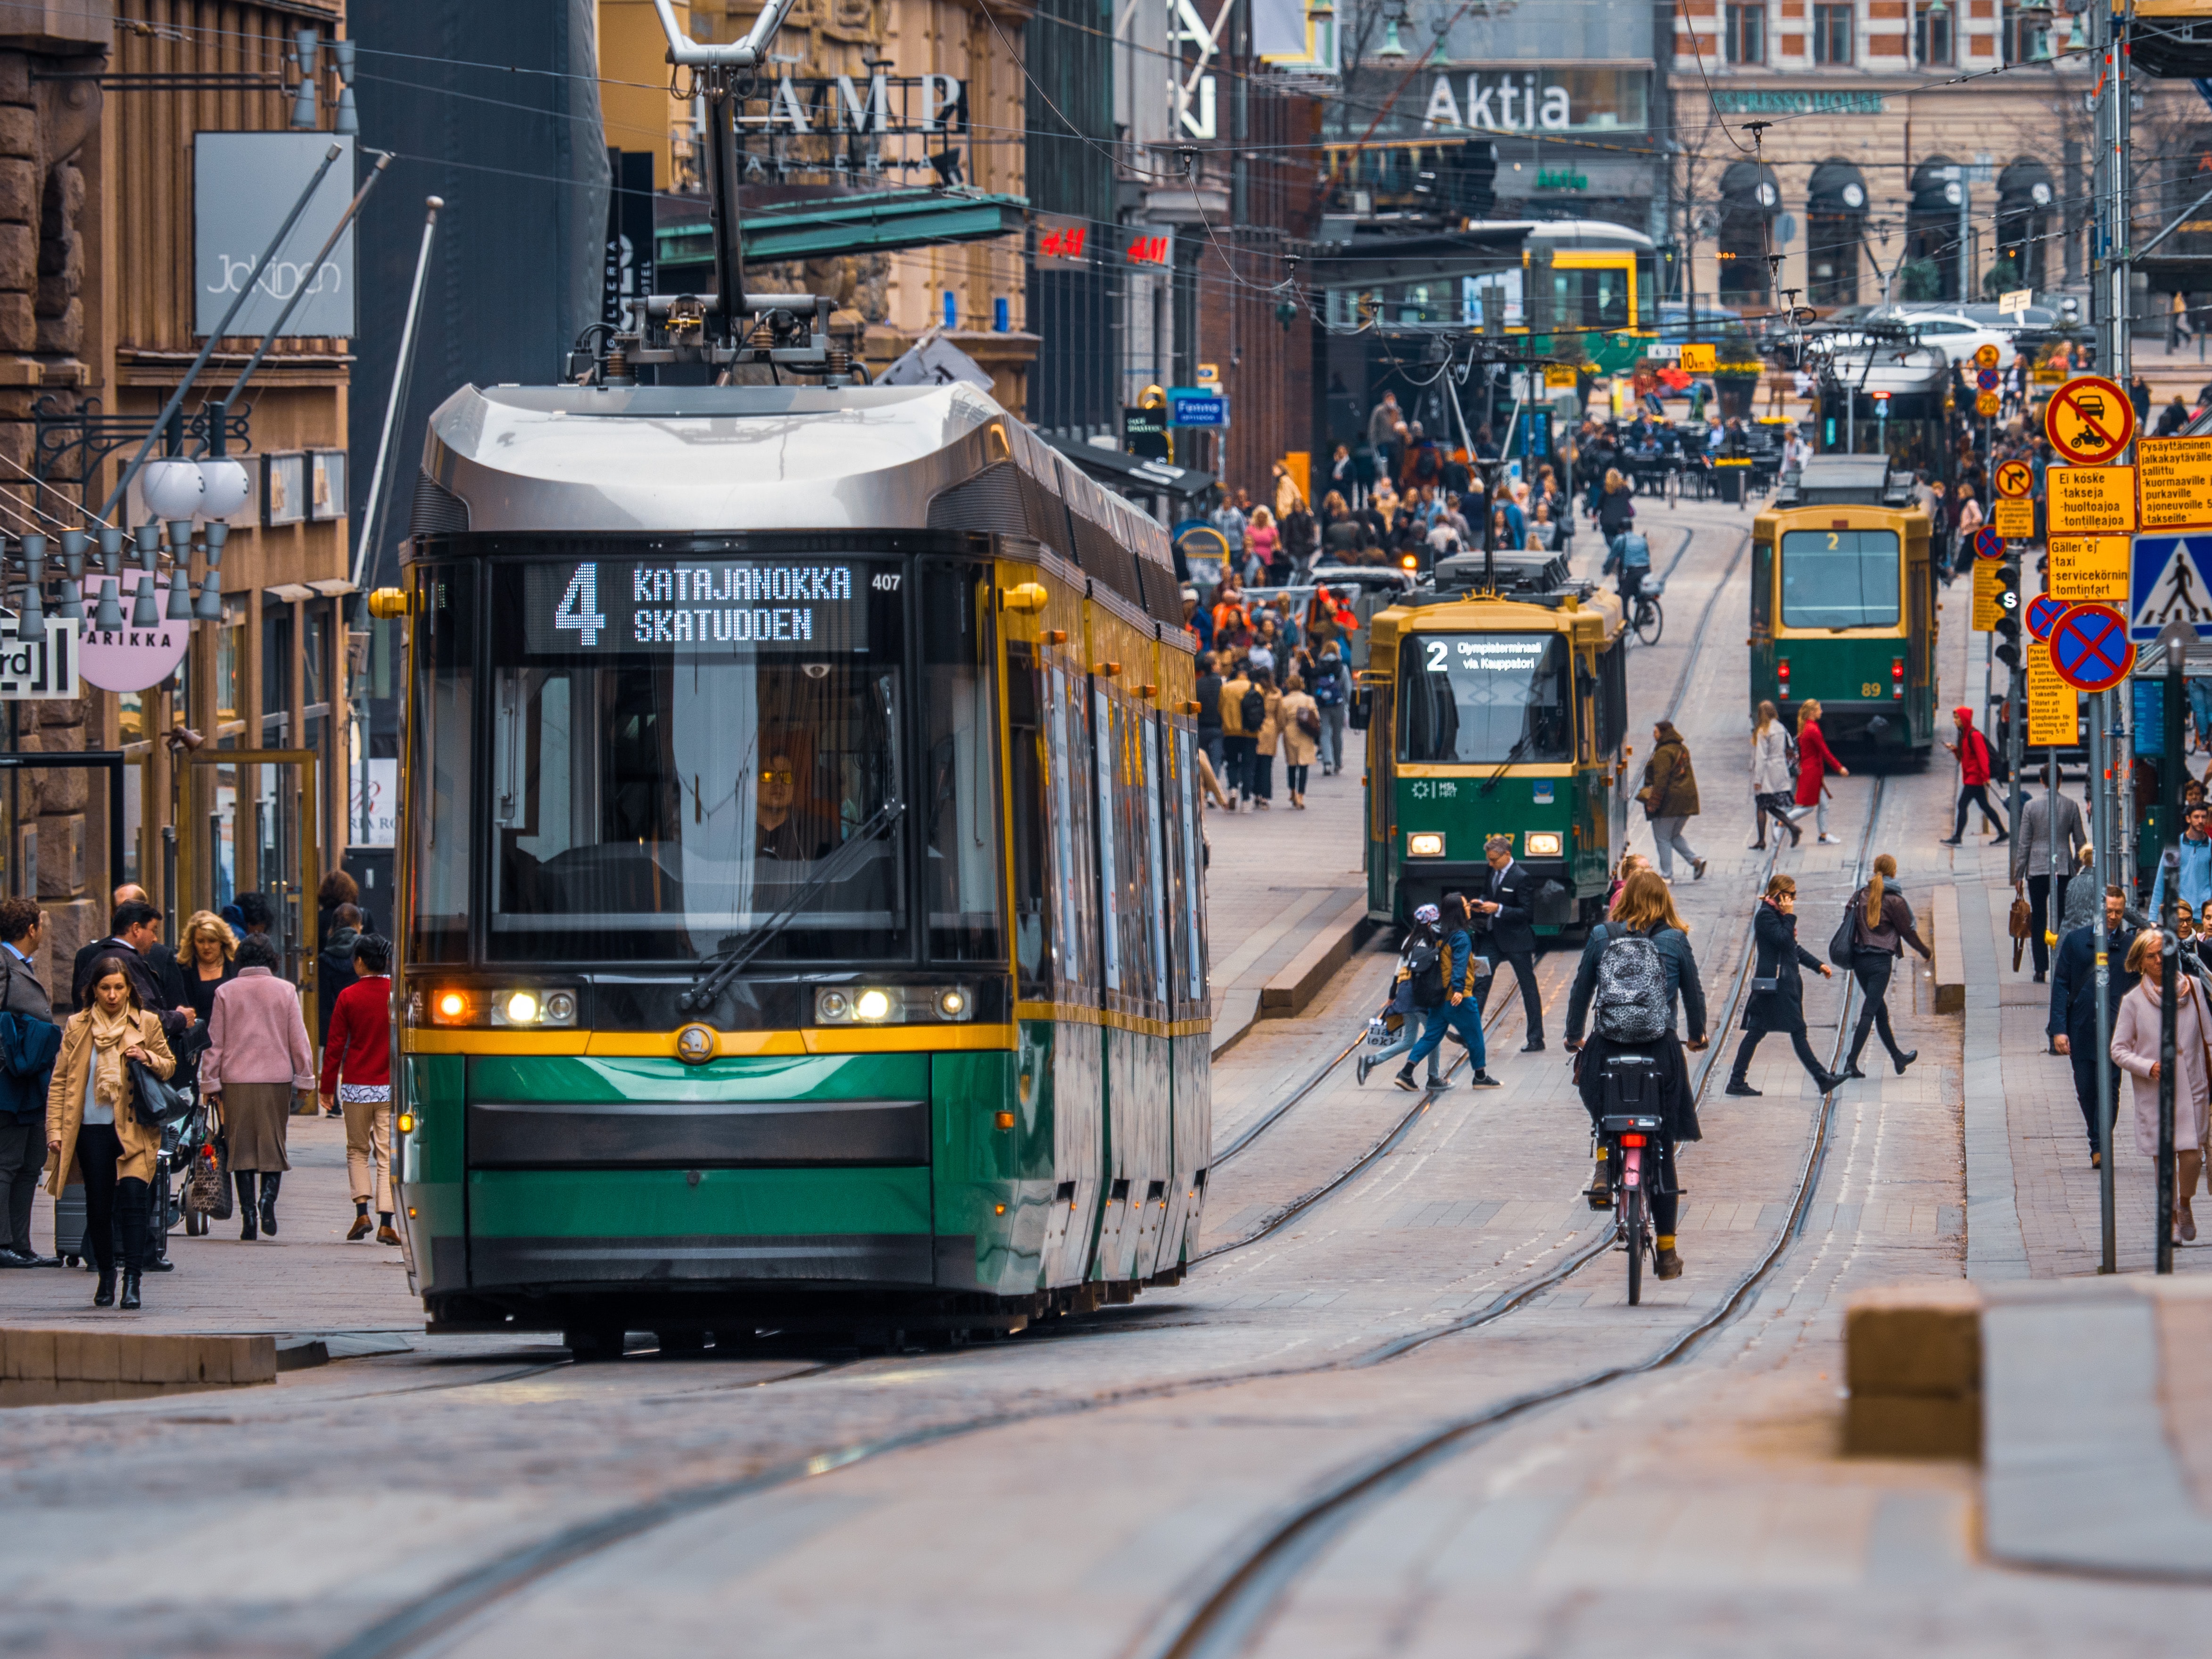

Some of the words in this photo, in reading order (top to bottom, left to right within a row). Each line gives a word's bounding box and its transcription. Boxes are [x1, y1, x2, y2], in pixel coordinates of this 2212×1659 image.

[1425, 73, 1571, 131] Aktia
[745, 153, 934, 174] ALLERIA
[641, 260, 652, 296] OTEL
[606, 241, 617, 348] GLLERIA
[1981, 398, 1997, 412] 20
[2141, 441, 2211, 453] Pysäyttäminen
[2142, 466, 2174, 476] sallittu
[2060, 473, 2069, 484] Ei
[2074, 473, 2104, 484] koske
[2142, 475, 2205, 487] -kuormaaville
[2060, 487, 2104, 499] -takseja
[2146, 489, 2192, 501] purkaville
[2060, 501, 2120, 513] -huoltoajoa
[2146, 500, 2203, 513] ajoneuvoille
[2061, 515, 2124, 527] -tontilleajoa
[2144, 513, 2187, 524] -takseille
[1827, 532, 1839, 550] 2
[2052, 542, 2082, 552] Gäller
[2087, 543, 2097, 554] ej
[2052, 556, 2075, 566] -taxi
[634, 567, 851, 601] KATAJANOKKA
[872, 574, 901, 591] 407
[2052, 584, 2110, 595] -tomtinfart
[555, 563, 605, 646] 4
[2004, 591, 2018, 608] S
[634, 609, 812, 642] SKATUDDEN
[79, 631, 171, 647] ARIKKA
[1426, 641, 1448, 672] 2
[1463, 657, 1479, 669] via
[1480, 657, 1535, 671] Kauppatori
[1861, 682, 1881, 697] 89
